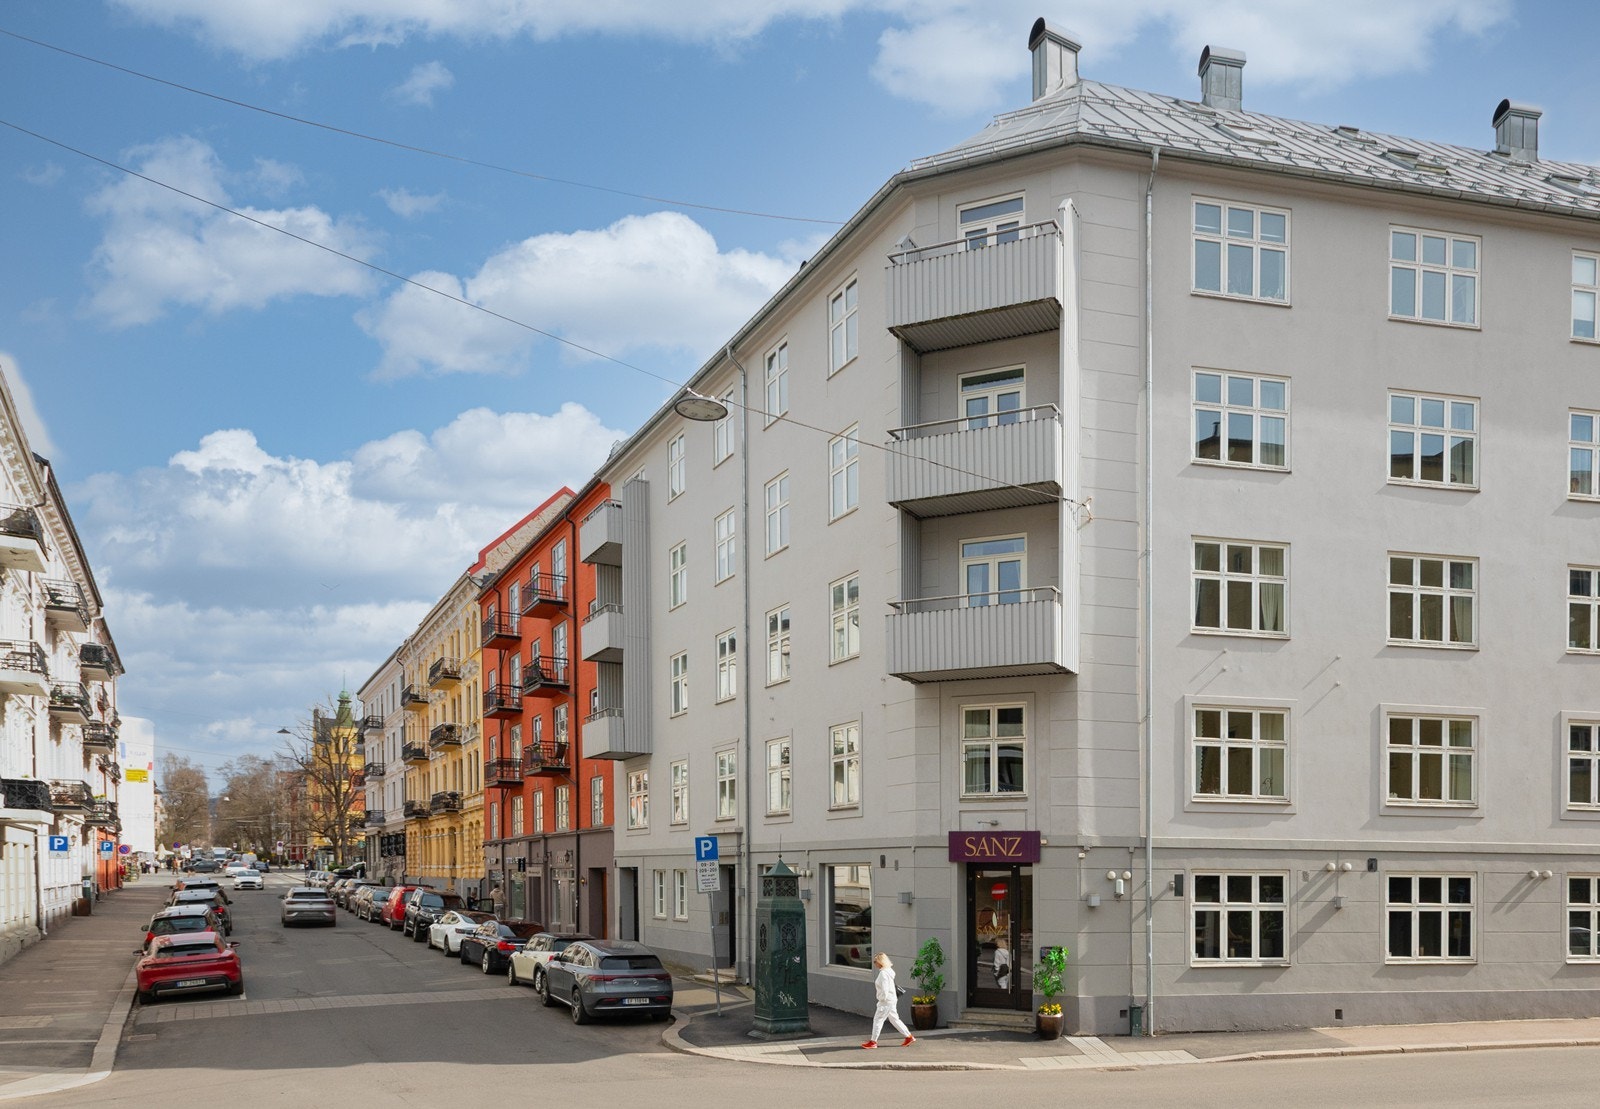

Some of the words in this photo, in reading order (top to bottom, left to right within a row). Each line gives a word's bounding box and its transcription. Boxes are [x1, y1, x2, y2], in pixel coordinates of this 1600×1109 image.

[53, 838, 65, 850] P
[103, 842, 111, 851] P
[700, 839, 713, 858] P
[964, 836, 1023, 856] SANZ
